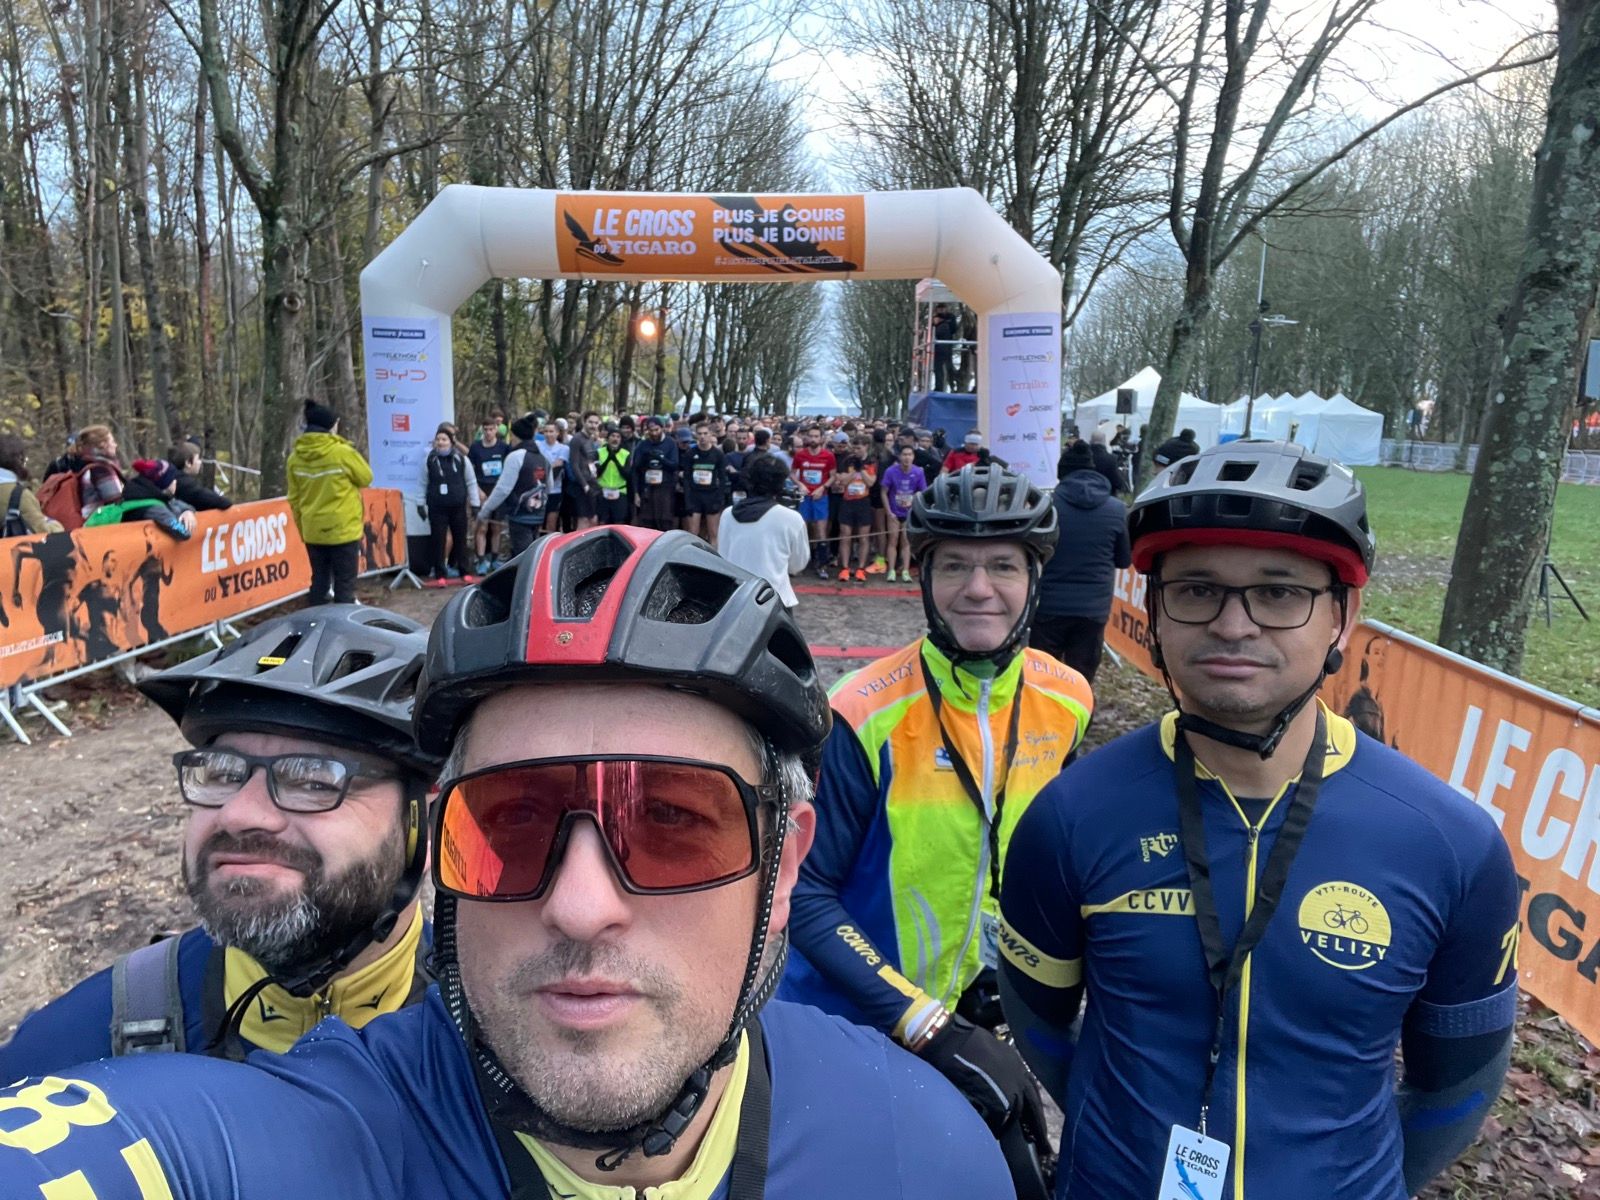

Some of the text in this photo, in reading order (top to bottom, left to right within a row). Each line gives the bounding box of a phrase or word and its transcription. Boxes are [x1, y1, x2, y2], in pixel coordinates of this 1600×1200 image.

[592, 208, 696, 236] LE CROSS
[712, 207, 845, 224] PLUS JE COURS
[606, 237, 697, 255] FIGARO
[712, 226, 845, 243] PLUS JE DONNE
[201, 511, 287, 574] LE CROSS
[204, 560, 289, 603] DU FIGARO
[857, 661, 914, 697] VELIZY
[1449, 704, 1532, 830] LE
[1128, 891, 1191, 912] CCVV
[1305, 886, 1379, 908] VTT-ROUTE
[1301, 930, 1387, 960] VELIZY
[1175, 1144, 1220, 1171] LE CROSS
